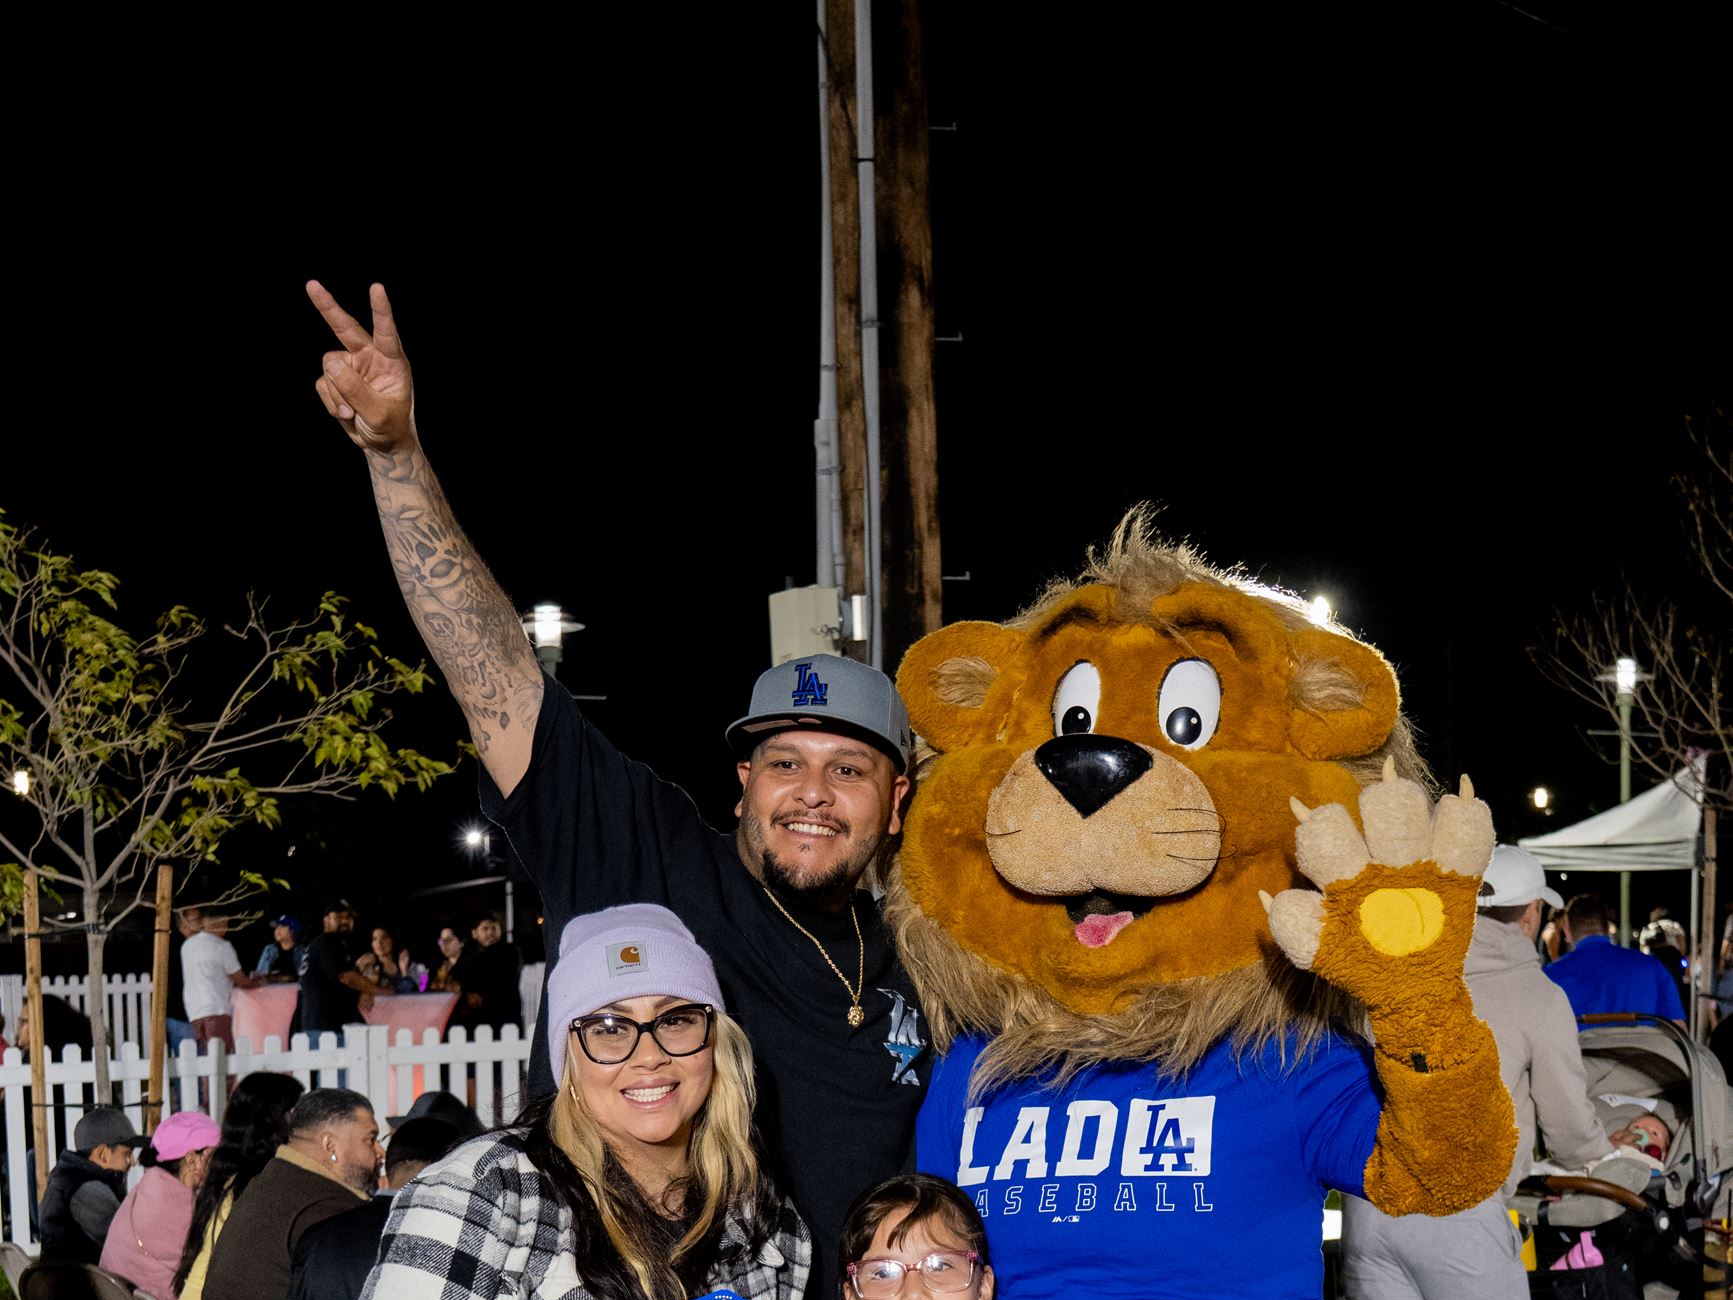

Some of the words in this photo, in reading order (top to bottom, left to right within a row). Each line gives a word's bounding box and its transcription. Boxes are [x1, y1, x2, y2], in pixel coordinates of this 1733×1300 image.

[792, 662, 828, 707] LA
[957, 1100, 1119, 1187] LAD
[1139, 1104, 1195, 1172] LA
[975, 1183, 1213, 1217] ASEBALL
